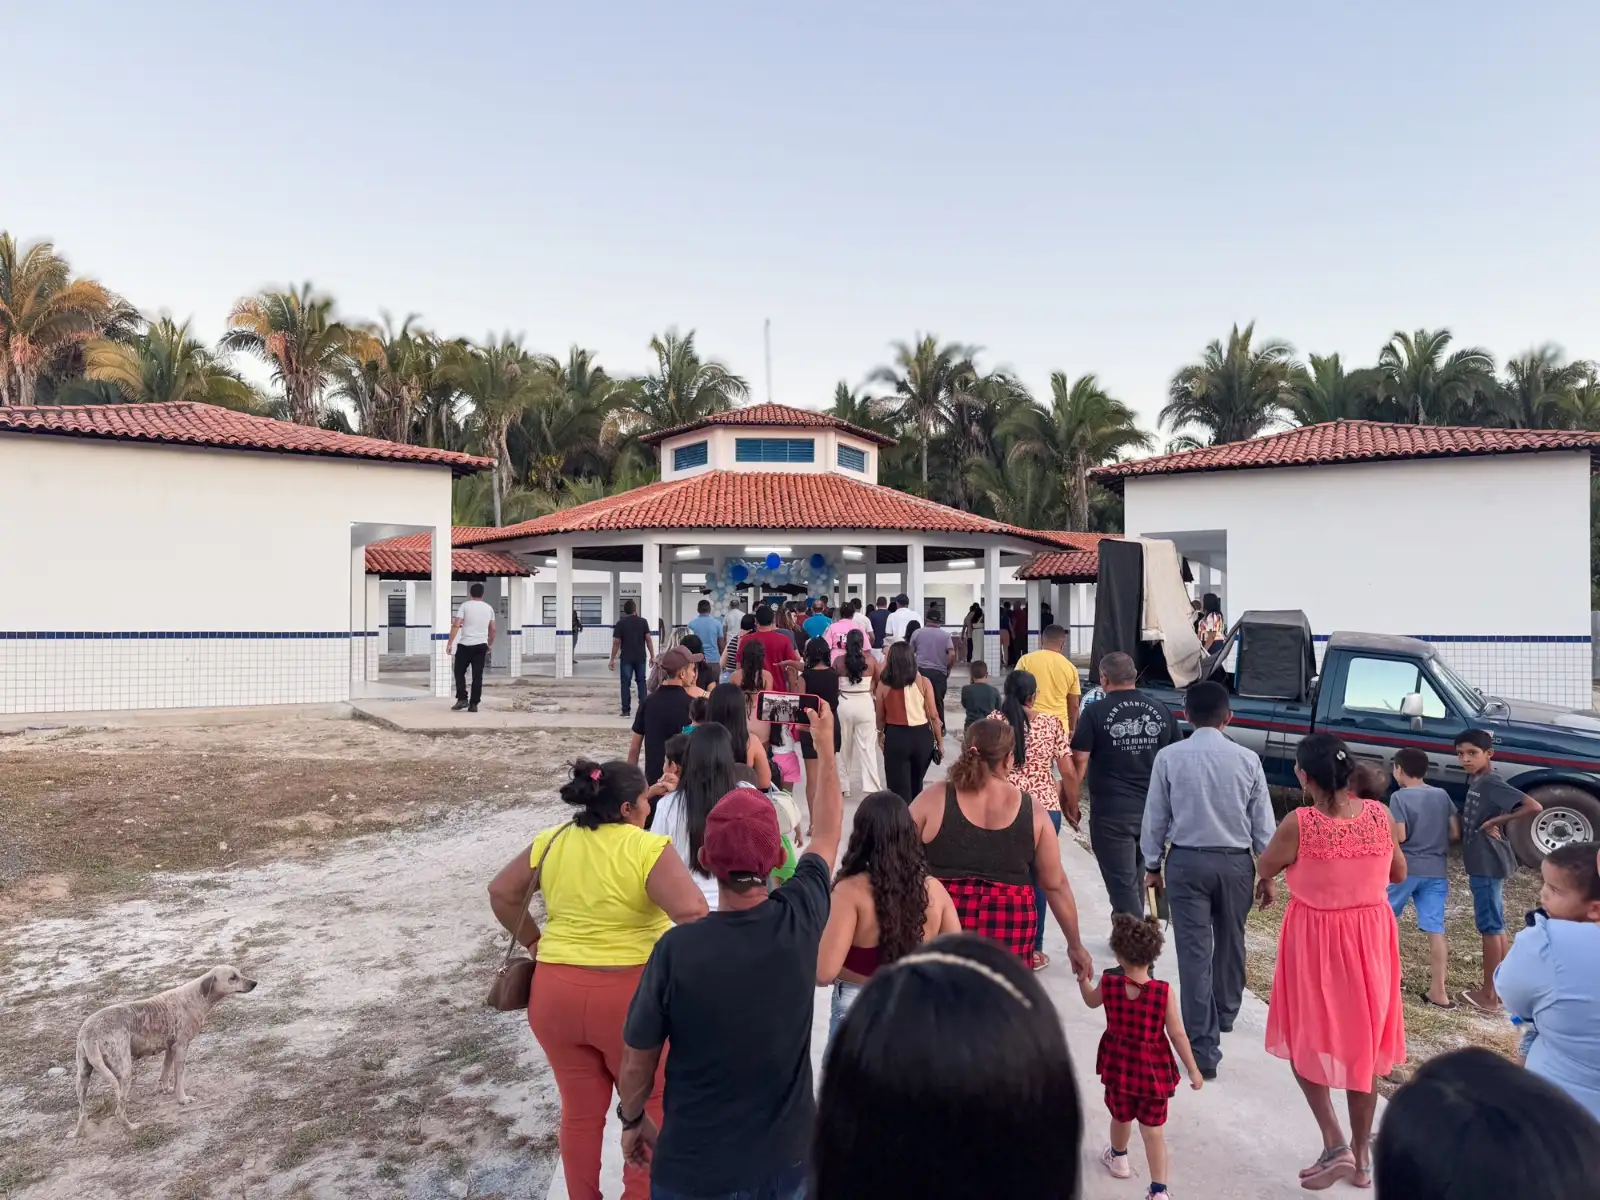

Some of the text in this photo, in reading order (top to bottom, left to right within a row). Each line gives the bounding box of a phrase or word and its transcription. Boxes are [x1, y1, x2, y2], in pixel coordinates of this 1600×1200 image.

[1106, 701, 1162, 723] SAN FRANCISCO
[1112, 737, 1159, 746] ROAD RUNNERS
